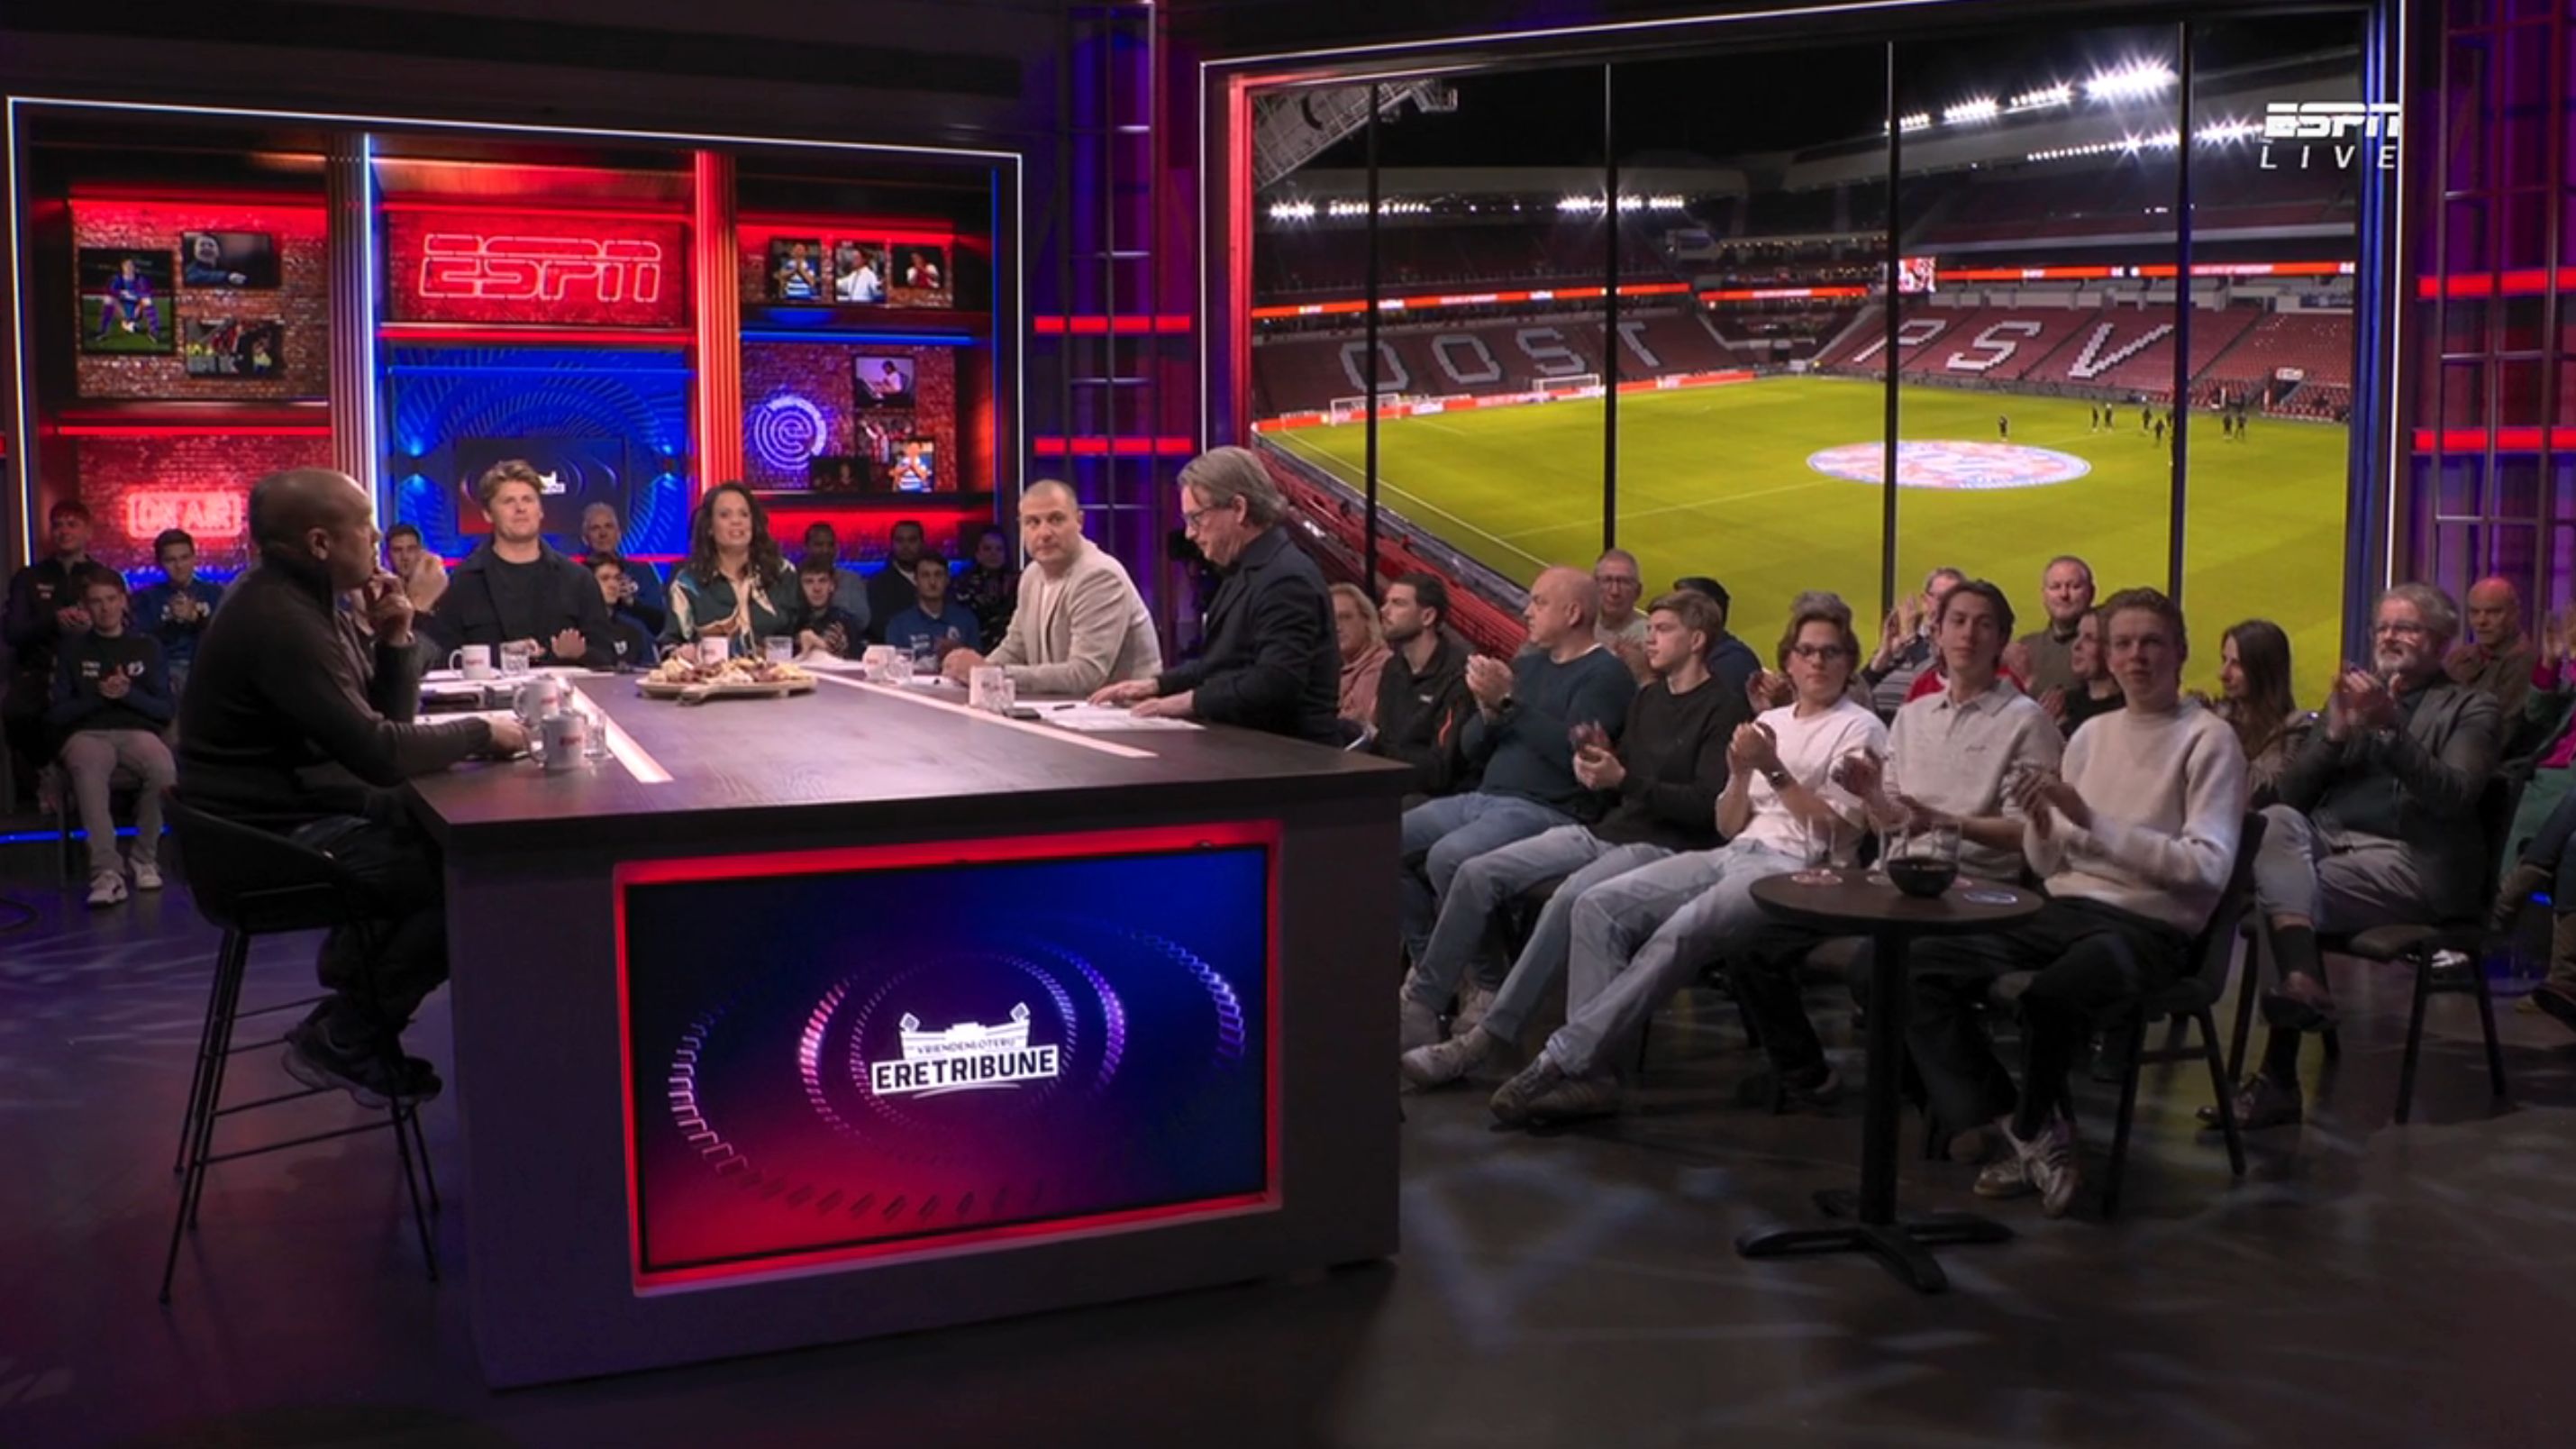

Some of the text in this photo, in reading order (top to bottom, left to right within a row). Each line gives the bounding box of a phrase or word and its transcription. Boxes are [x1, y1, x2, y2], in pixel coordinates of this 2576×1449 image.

[419, 233, 661, 303] ESPN
[1340, 321, 1660, 391] OOST
[1852, 319, 2173, 378] PSV
[138, 498, 232, 529] ON AIR
[876, 1049, 1054, 1090] ERETRIBUNE
